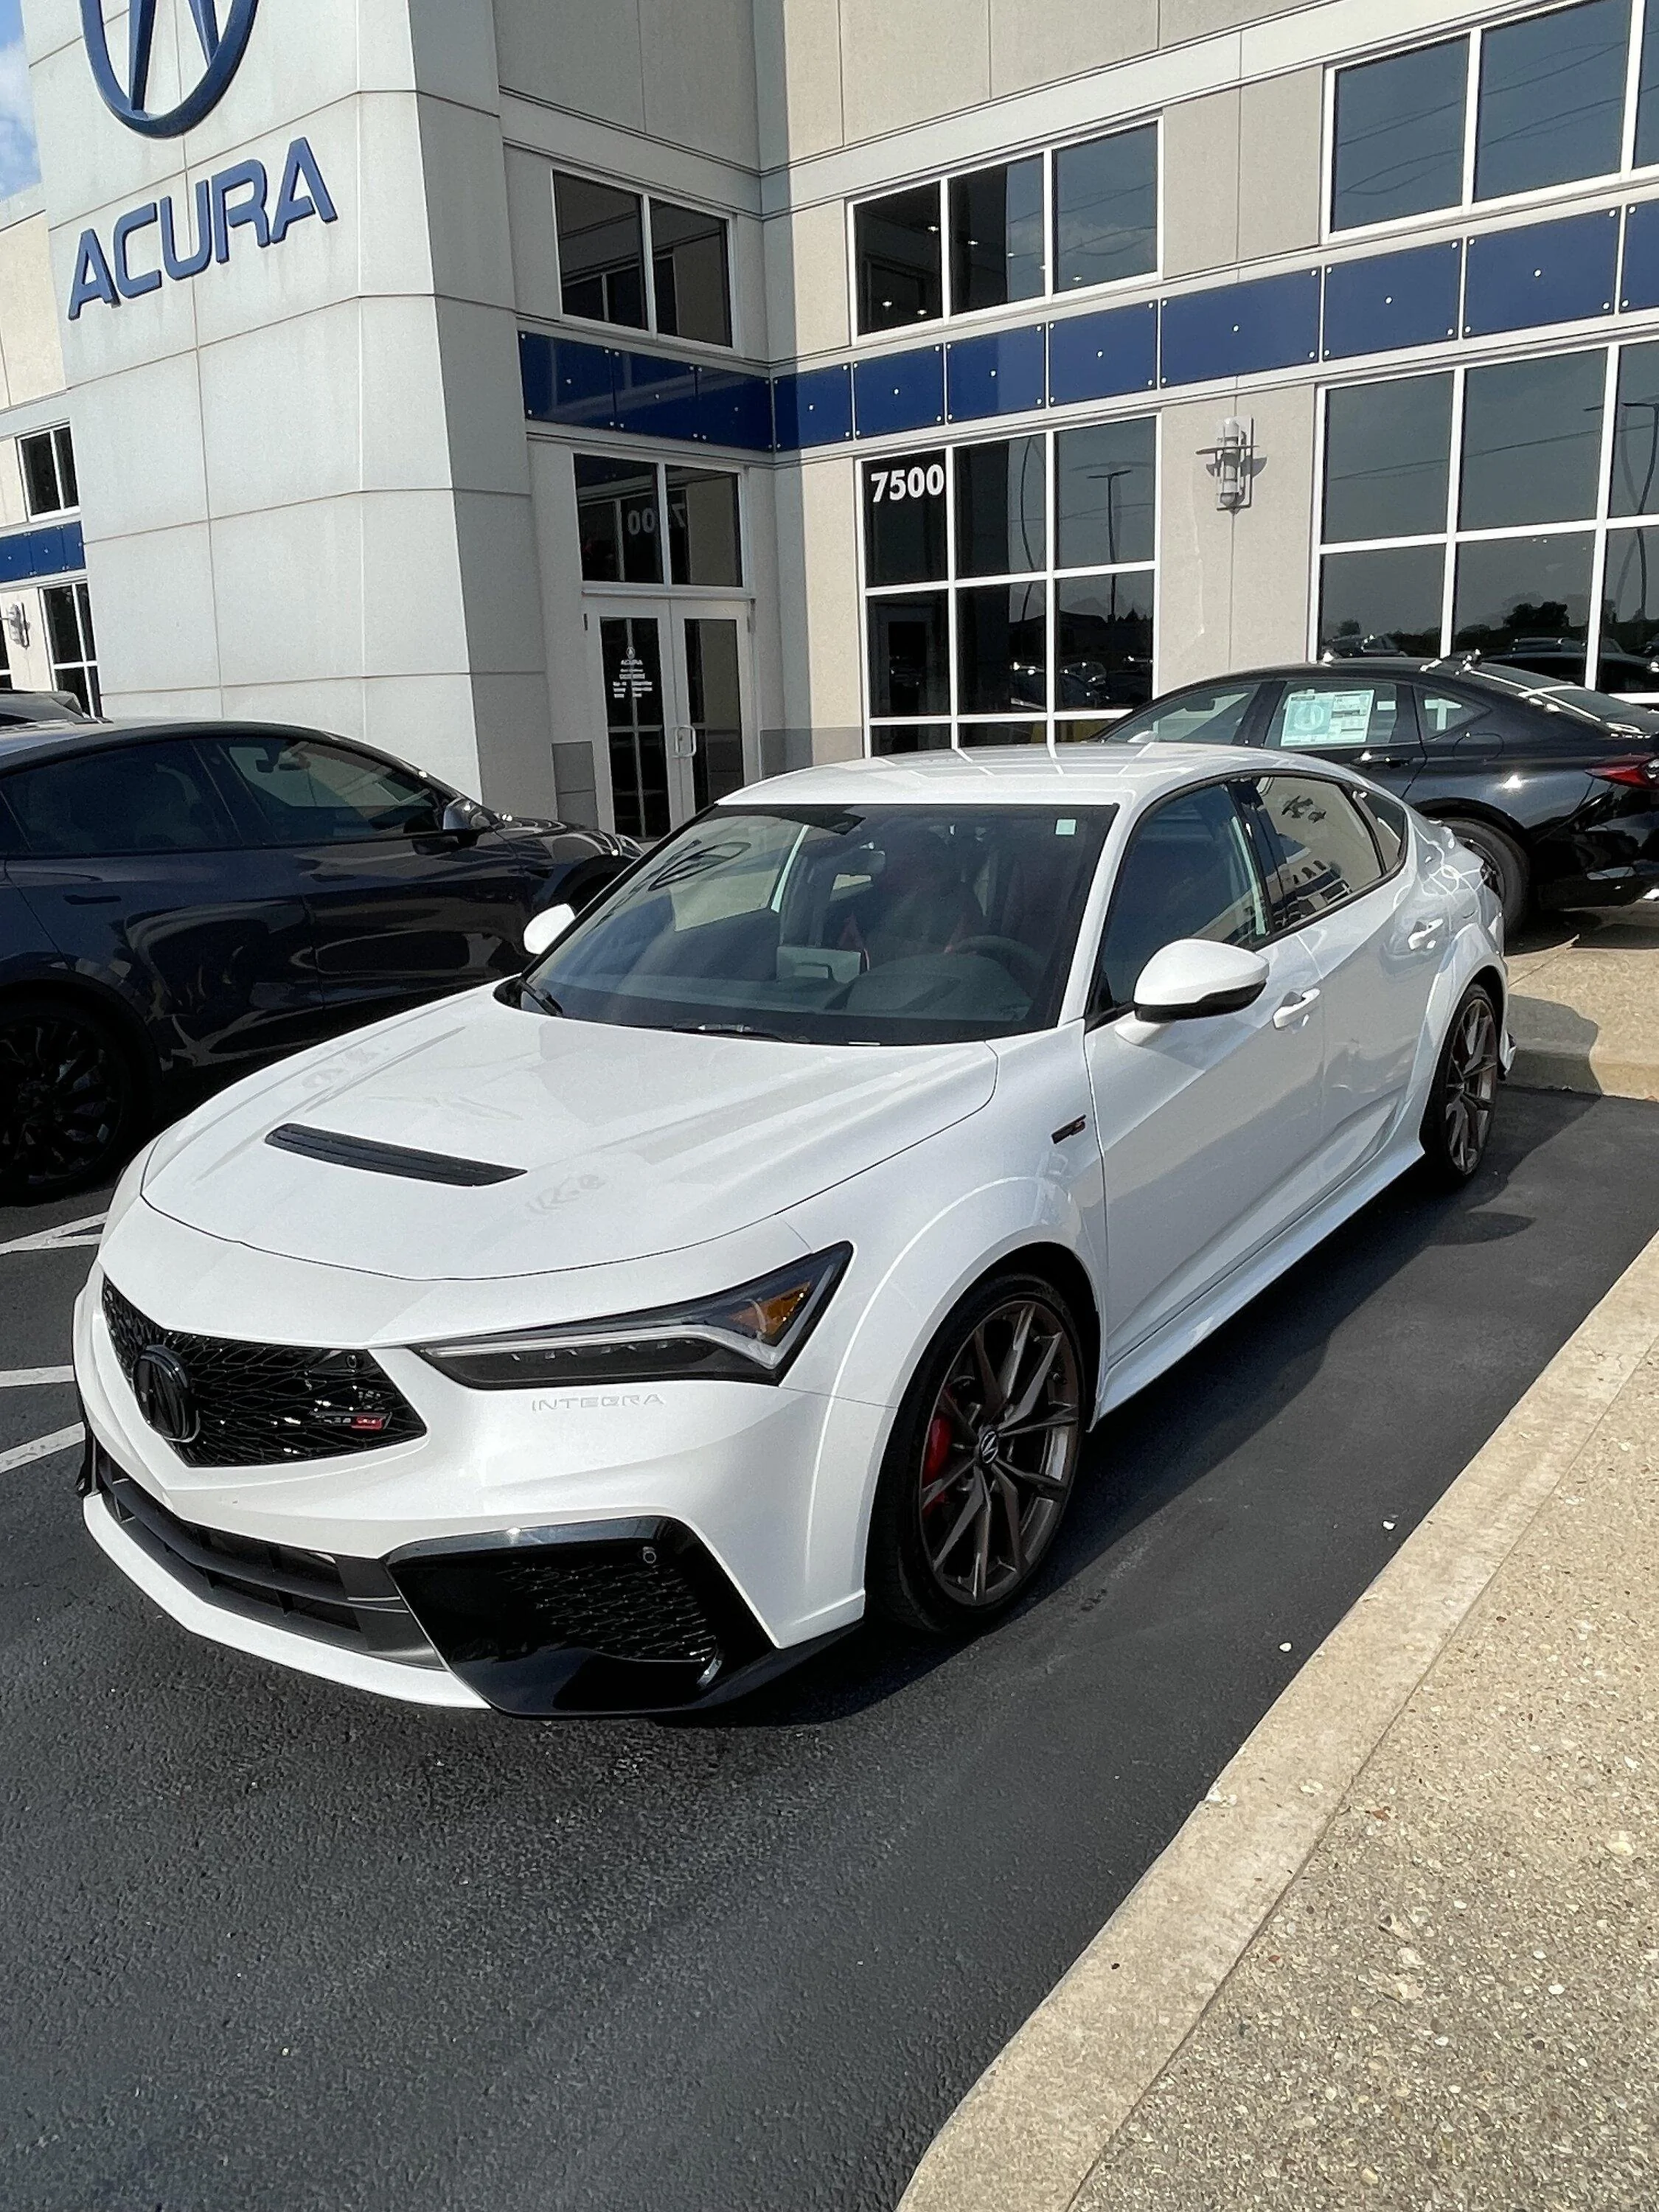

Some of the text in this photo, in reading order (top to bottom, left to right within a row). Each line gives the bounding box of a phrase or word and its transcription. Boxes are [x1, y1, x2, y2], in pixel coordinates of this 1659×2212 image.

[68, 136, 338, 321] ACURA
[871, 464, 945, 503] 7500
[532, 1393, 664, 1411] INTEGRA
